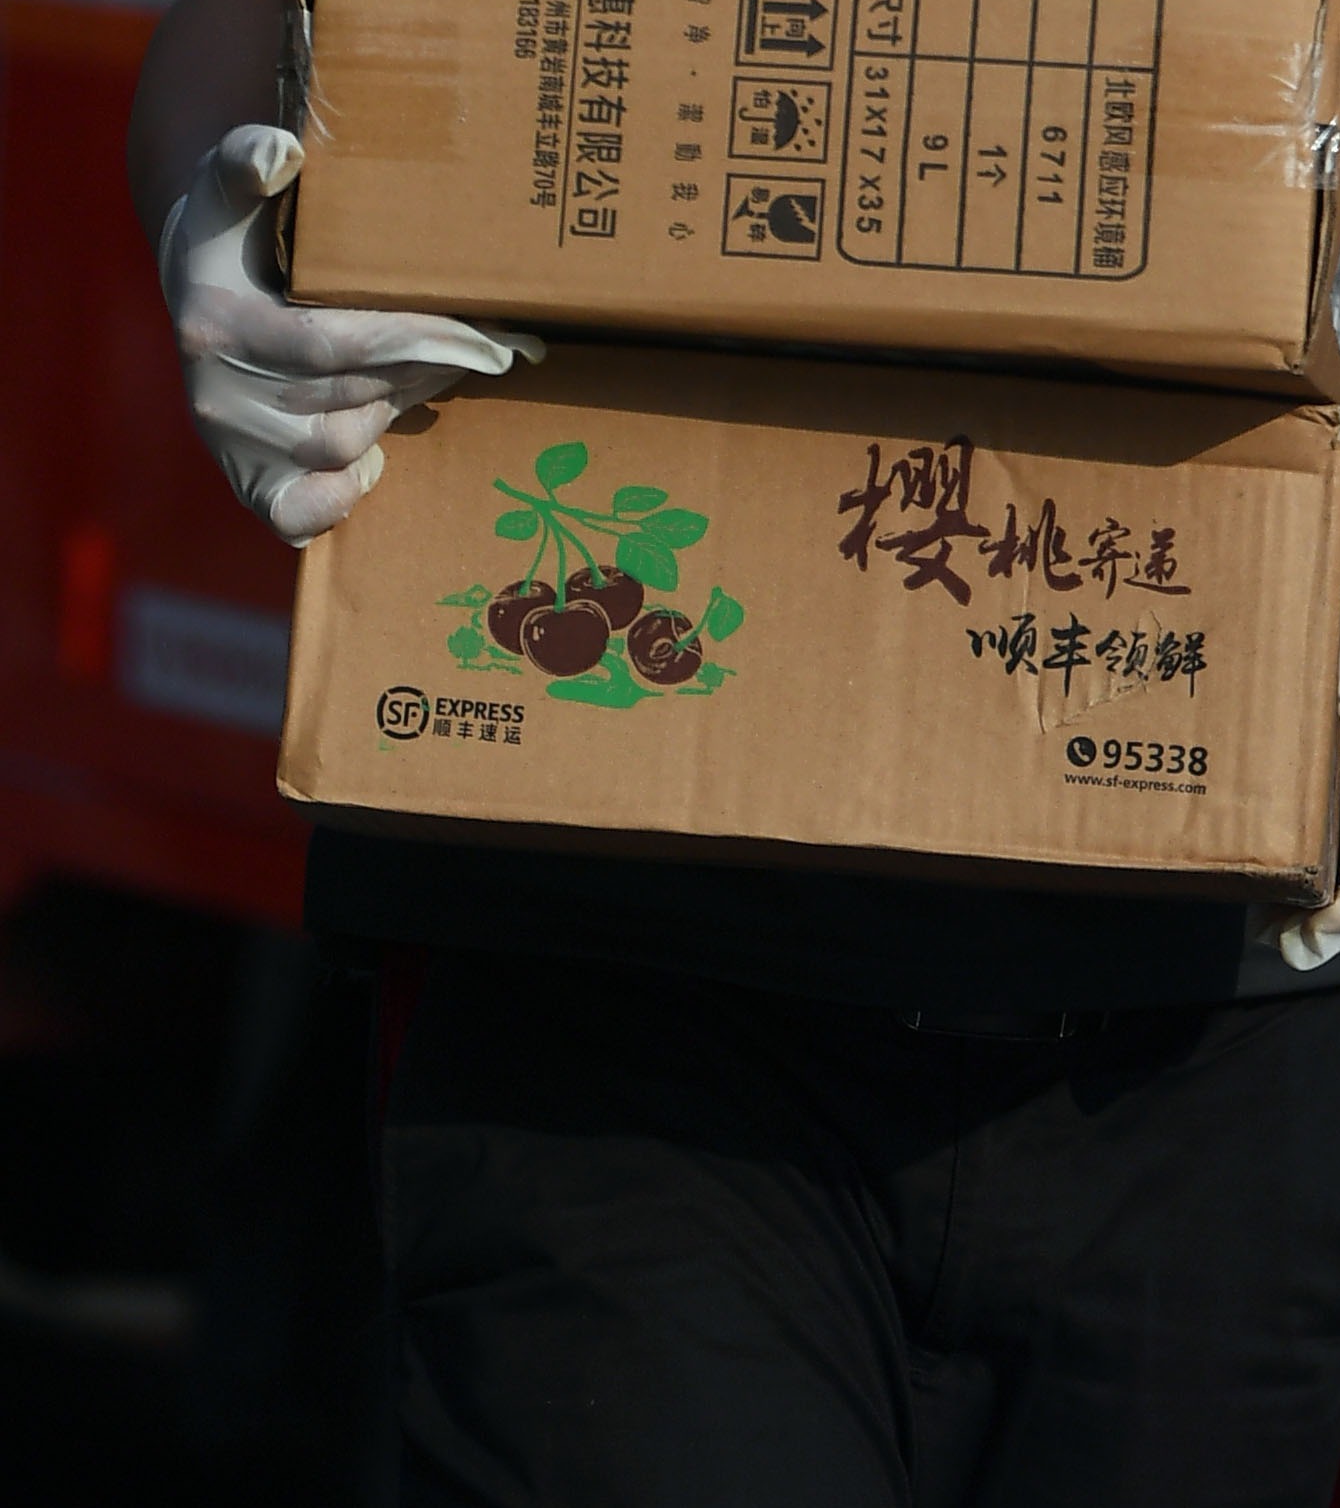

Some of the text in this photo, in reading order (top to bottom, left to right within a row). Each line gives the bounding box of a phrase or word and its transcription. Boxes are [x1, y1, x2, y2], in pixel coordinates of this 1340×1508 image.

[760, 16, 808, 38] 向上
[976, 144, 1008, 188] 1个
[1036, 124, 1068, 205] 6711
[747, 185, 771, 243] 易碎
[386, 699, 421, 728] SF
[435, 697, 526, 724] EXPRESS
[432, 718, 523, 746] 顺丰速运
[1102, 738, 1209, 777] 95338
[1063, 772, 1208, 796] www.sf-express.com
